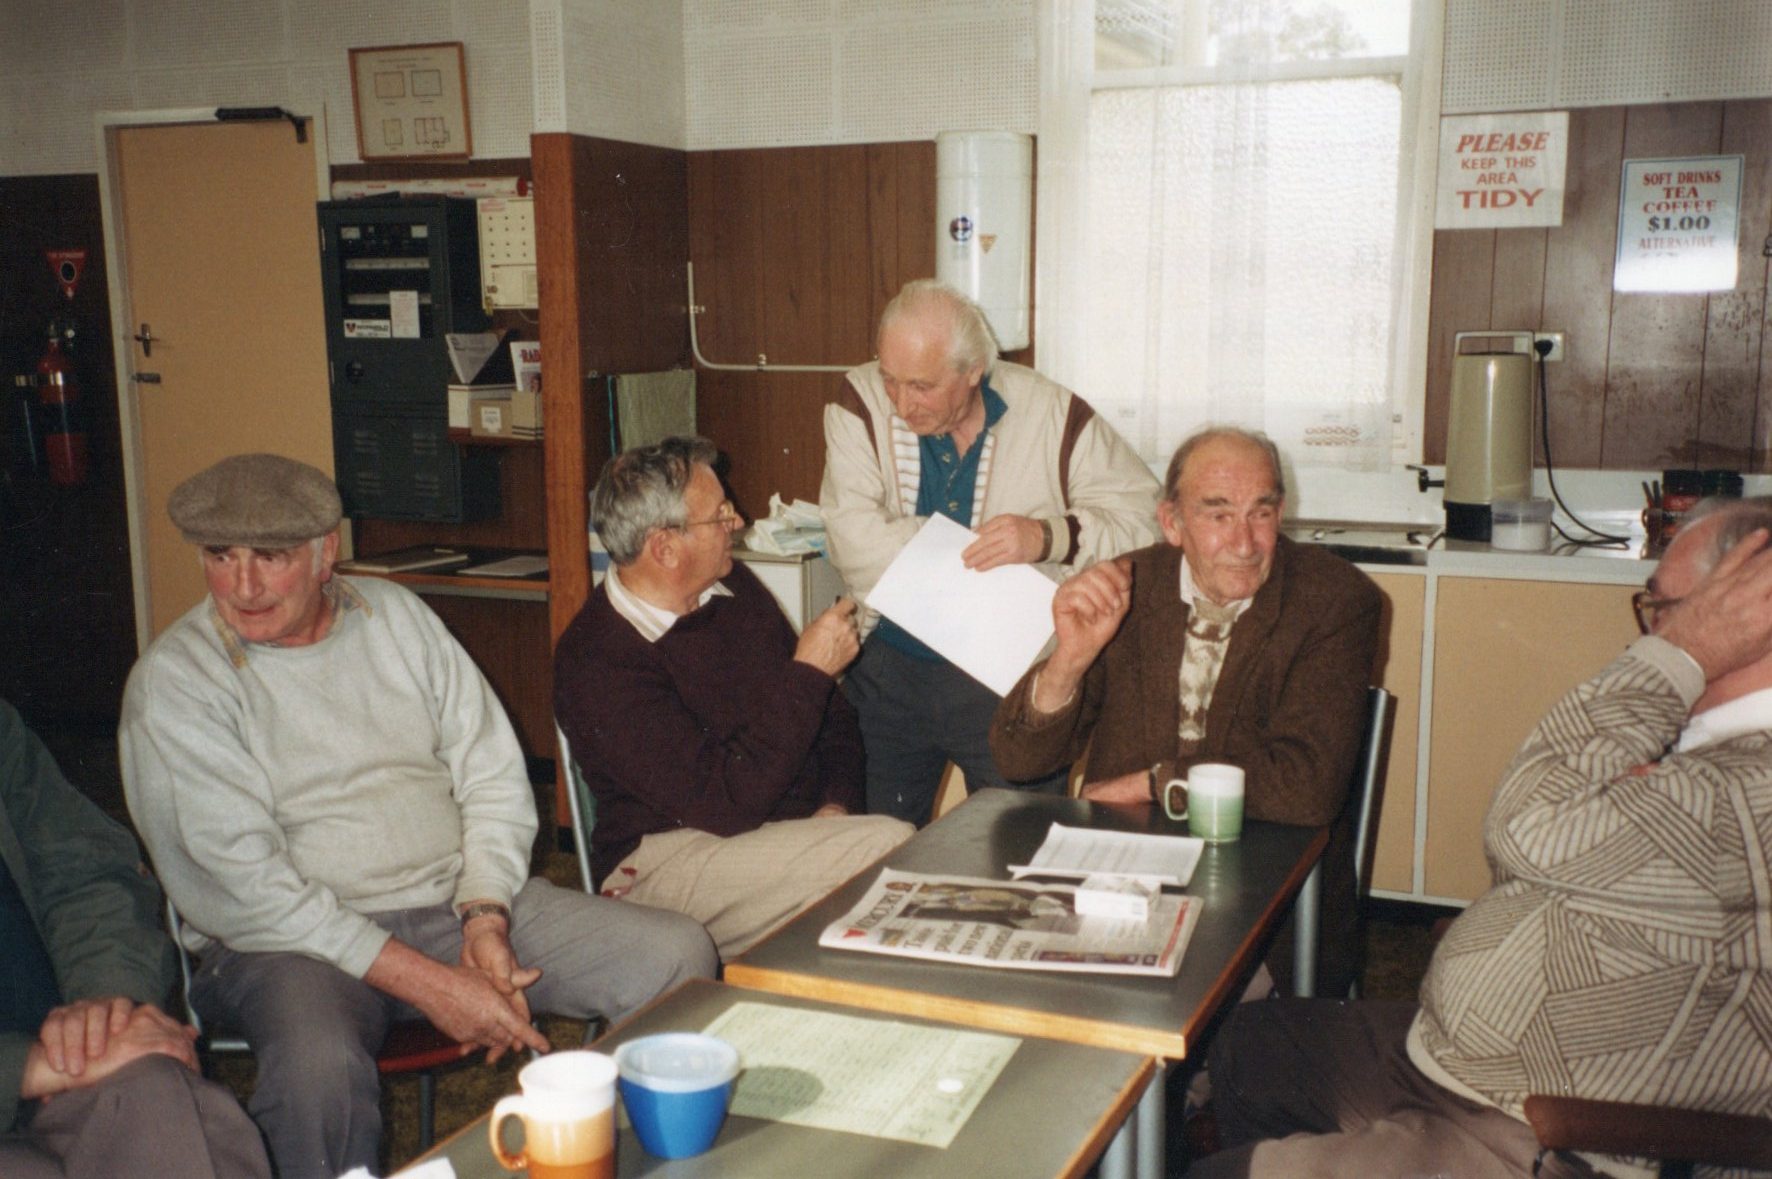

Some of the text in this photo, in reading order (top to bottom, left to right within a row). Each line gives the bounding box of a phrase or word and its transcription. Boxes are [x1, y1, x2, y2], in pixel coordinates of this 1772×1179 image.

[1456, 132, 1549, 153] PLEASE
[1461, 156, 1536, 169] KEEP THIS
[1476, 172, 1518, 184] AREA
[1643, 170, 1721, 186] SOFT DRINKS
[1456, 188, 1545, 209] TIDY
[1663, 186, 1699, 199] TEA
[1643, 200, 1717, 213] COFFEE
[1648, 215, 1710, 233] $1.00
